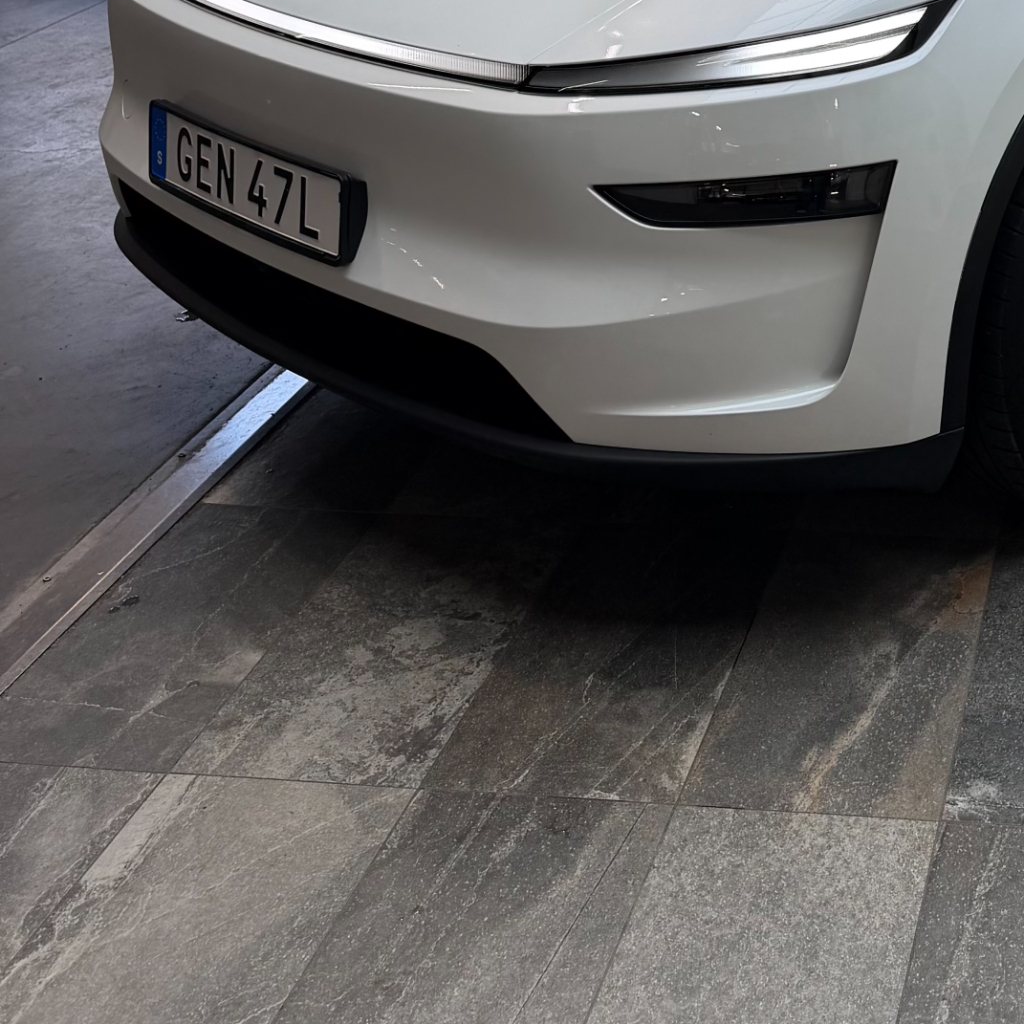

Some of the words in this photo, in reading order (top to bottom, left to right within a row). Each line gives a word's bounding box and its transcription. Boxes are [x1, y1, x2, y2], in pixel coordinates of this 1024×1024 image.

[157, 150, 163, 165] S
[177, 127, 235, 205] GEN
[248, 159, 320, 240] 47L
